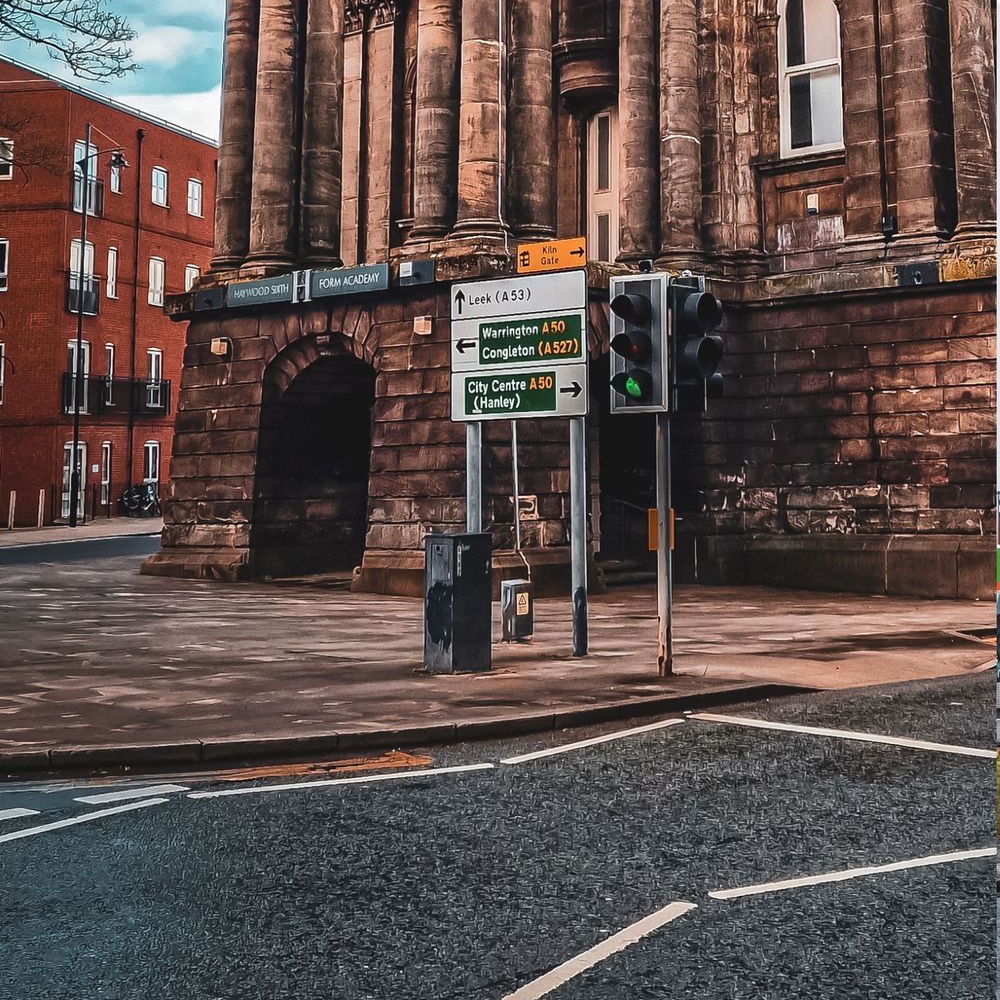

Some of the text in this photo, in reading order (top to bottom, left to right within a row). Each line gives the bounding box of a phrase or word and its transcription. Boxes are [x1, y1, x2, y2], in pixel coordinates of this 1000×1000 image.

[542, 246, 557, 255] Kiln
[540, 256, 559, 265] Gate
[319, 272, 380, 289] FORM ACADEMY
[233, 283, 289, 298] HAYWOOD SIXTH
[469, 287, 531, 306] Leek (A53)
[482, 320, 565, 340] Warrington A50
[482, 339, 579, 360] Congleton (A527)
[468, 376, 553, 395] City Centre A50
[473, 393, 521, 411] (Hanley)
